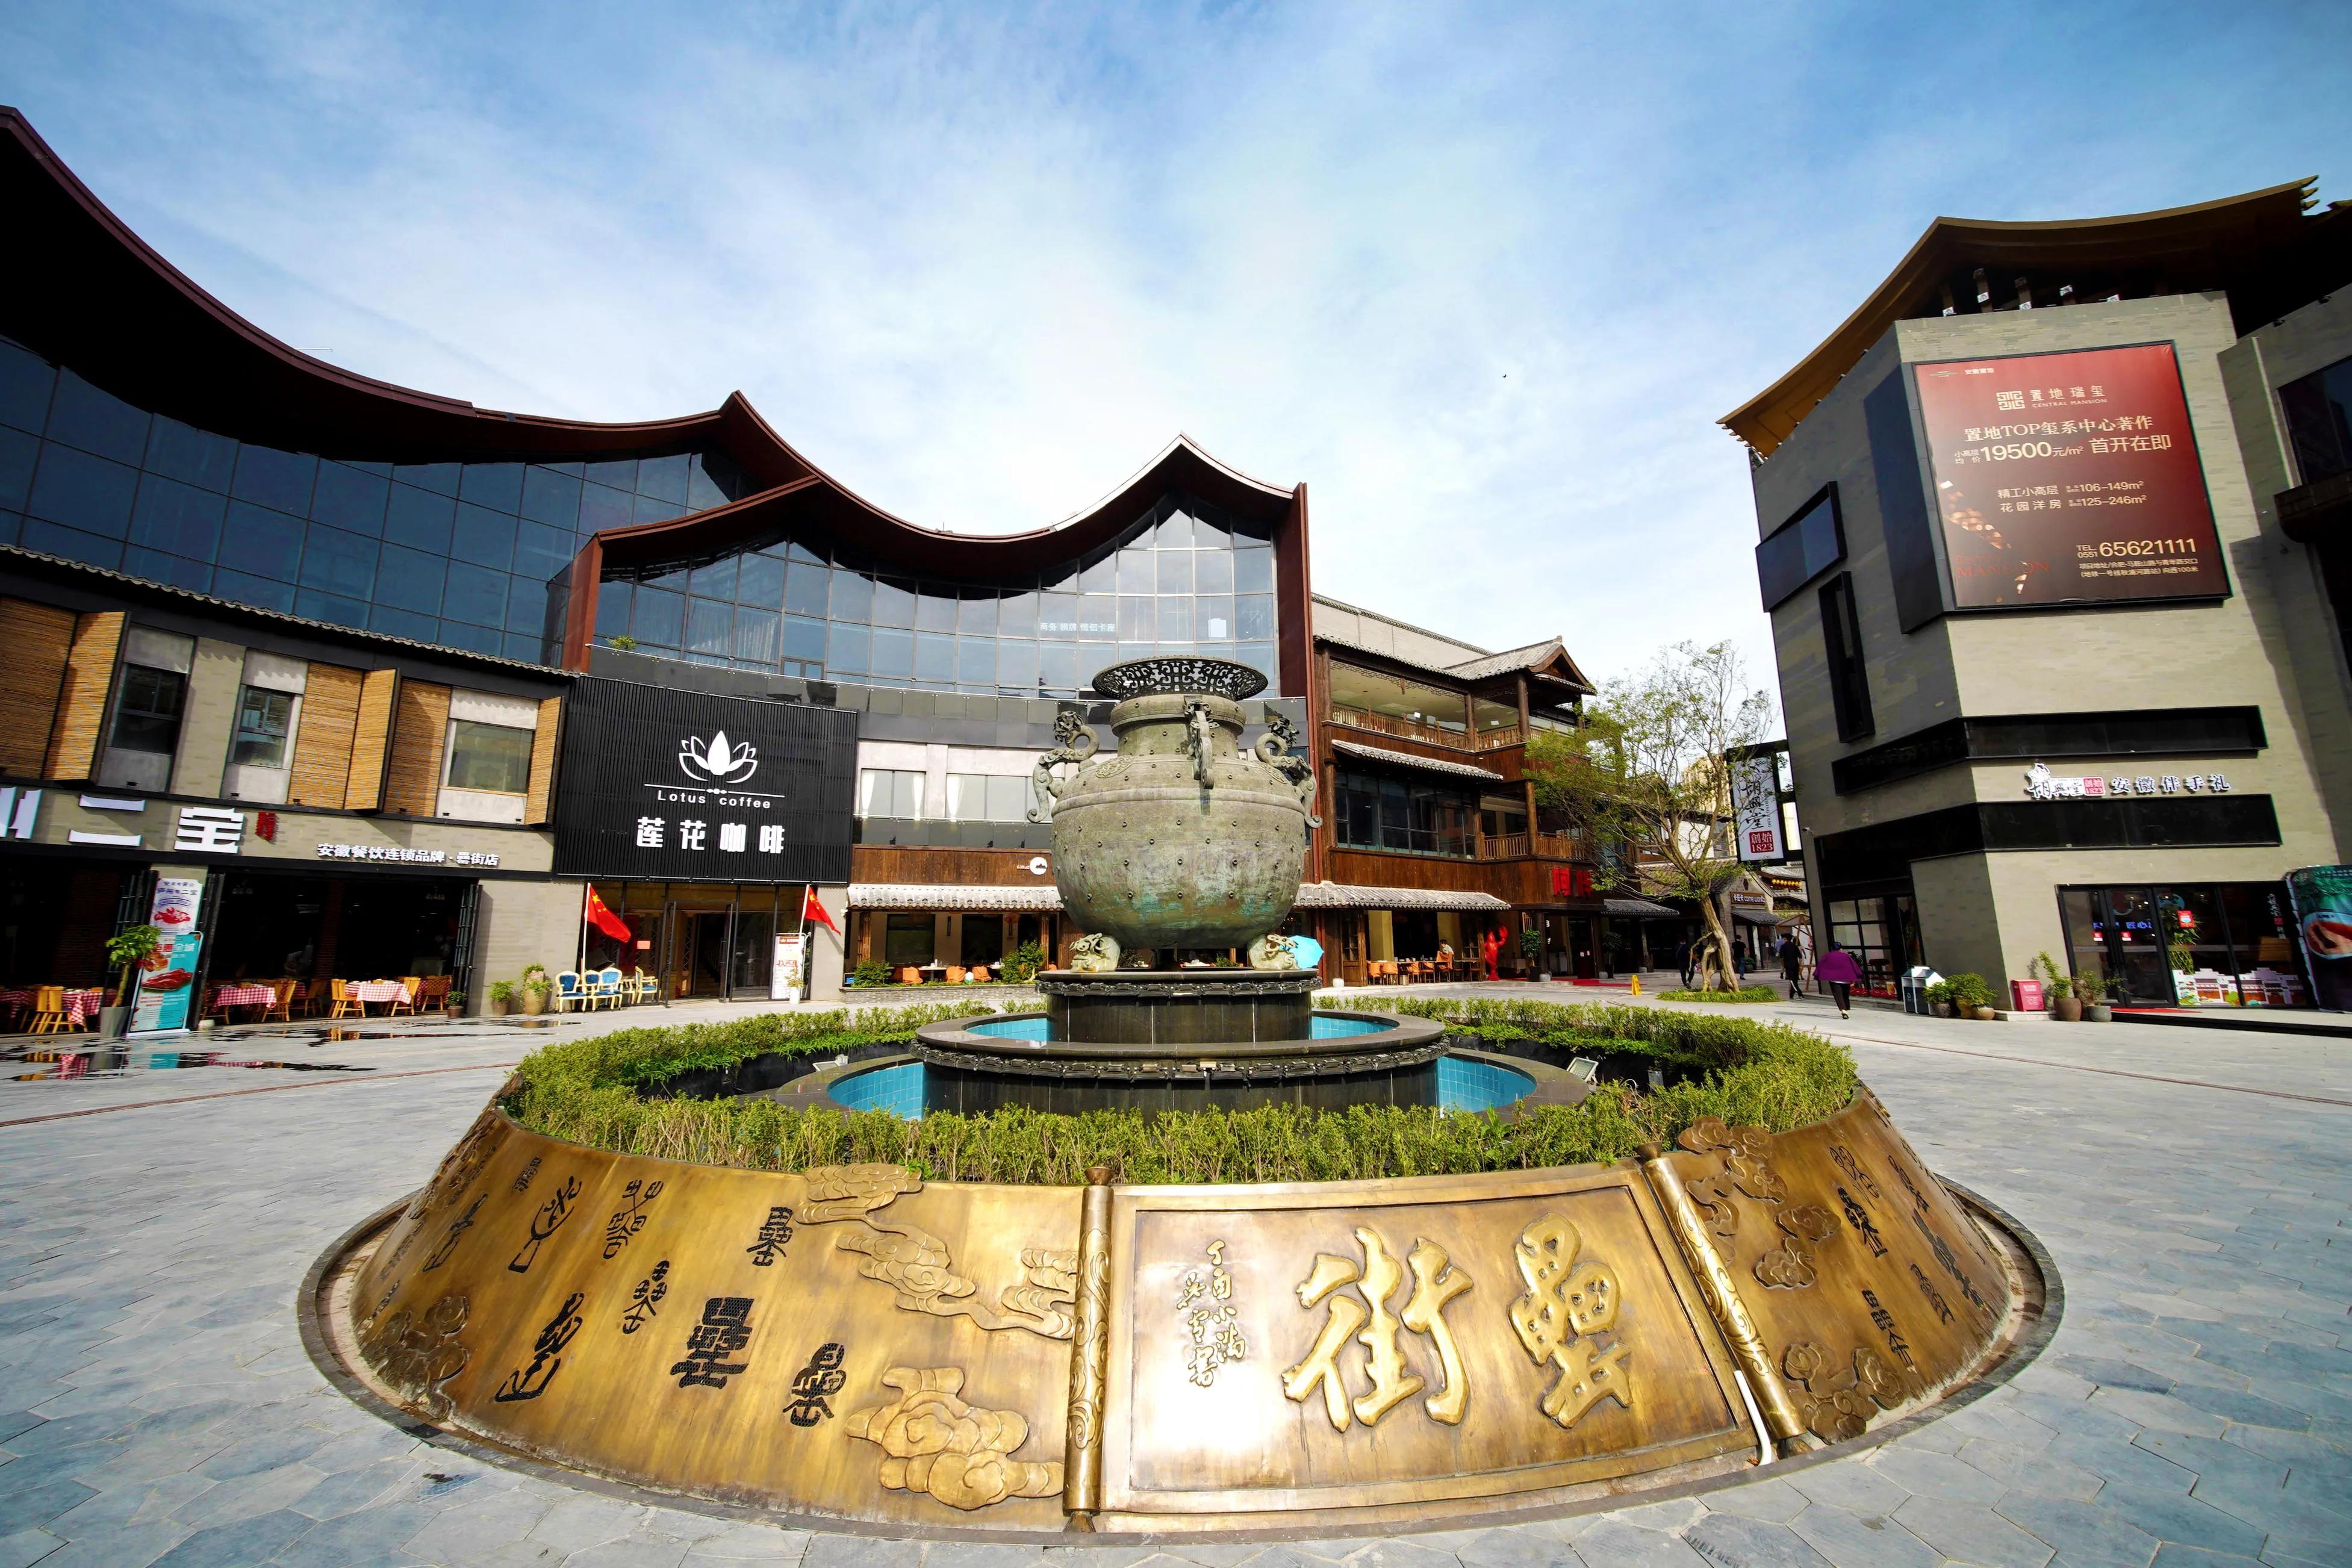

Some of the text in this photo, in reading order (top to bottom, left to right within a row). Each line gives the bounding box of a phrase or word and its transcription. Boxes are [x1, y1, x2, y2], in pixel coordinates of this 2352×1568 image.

[2030, 385, 2105, 402] 置地瑞玺
[1964, 415, 2153, 442] 置地TOP玺系中心著作
[2089, 434, 2173, 454] 首开在即
[1997, 485, 2059, 499] 精工小高层
[2000, 499, 2062, 512] 花园洋房
[2099, 538, 2197, 557] 65621111
[1040, 623, 1057, 631] 商务
[1080, 623, 1115, 632] 情侣卡座
[2111, 774, 2230, 794] 安徽伴手礼
[658, 791, 771, 809] Lotus coffee
[636, 817, 785, 854] 莲花咖啡
[1752, 844, 1773, 852] 1823
